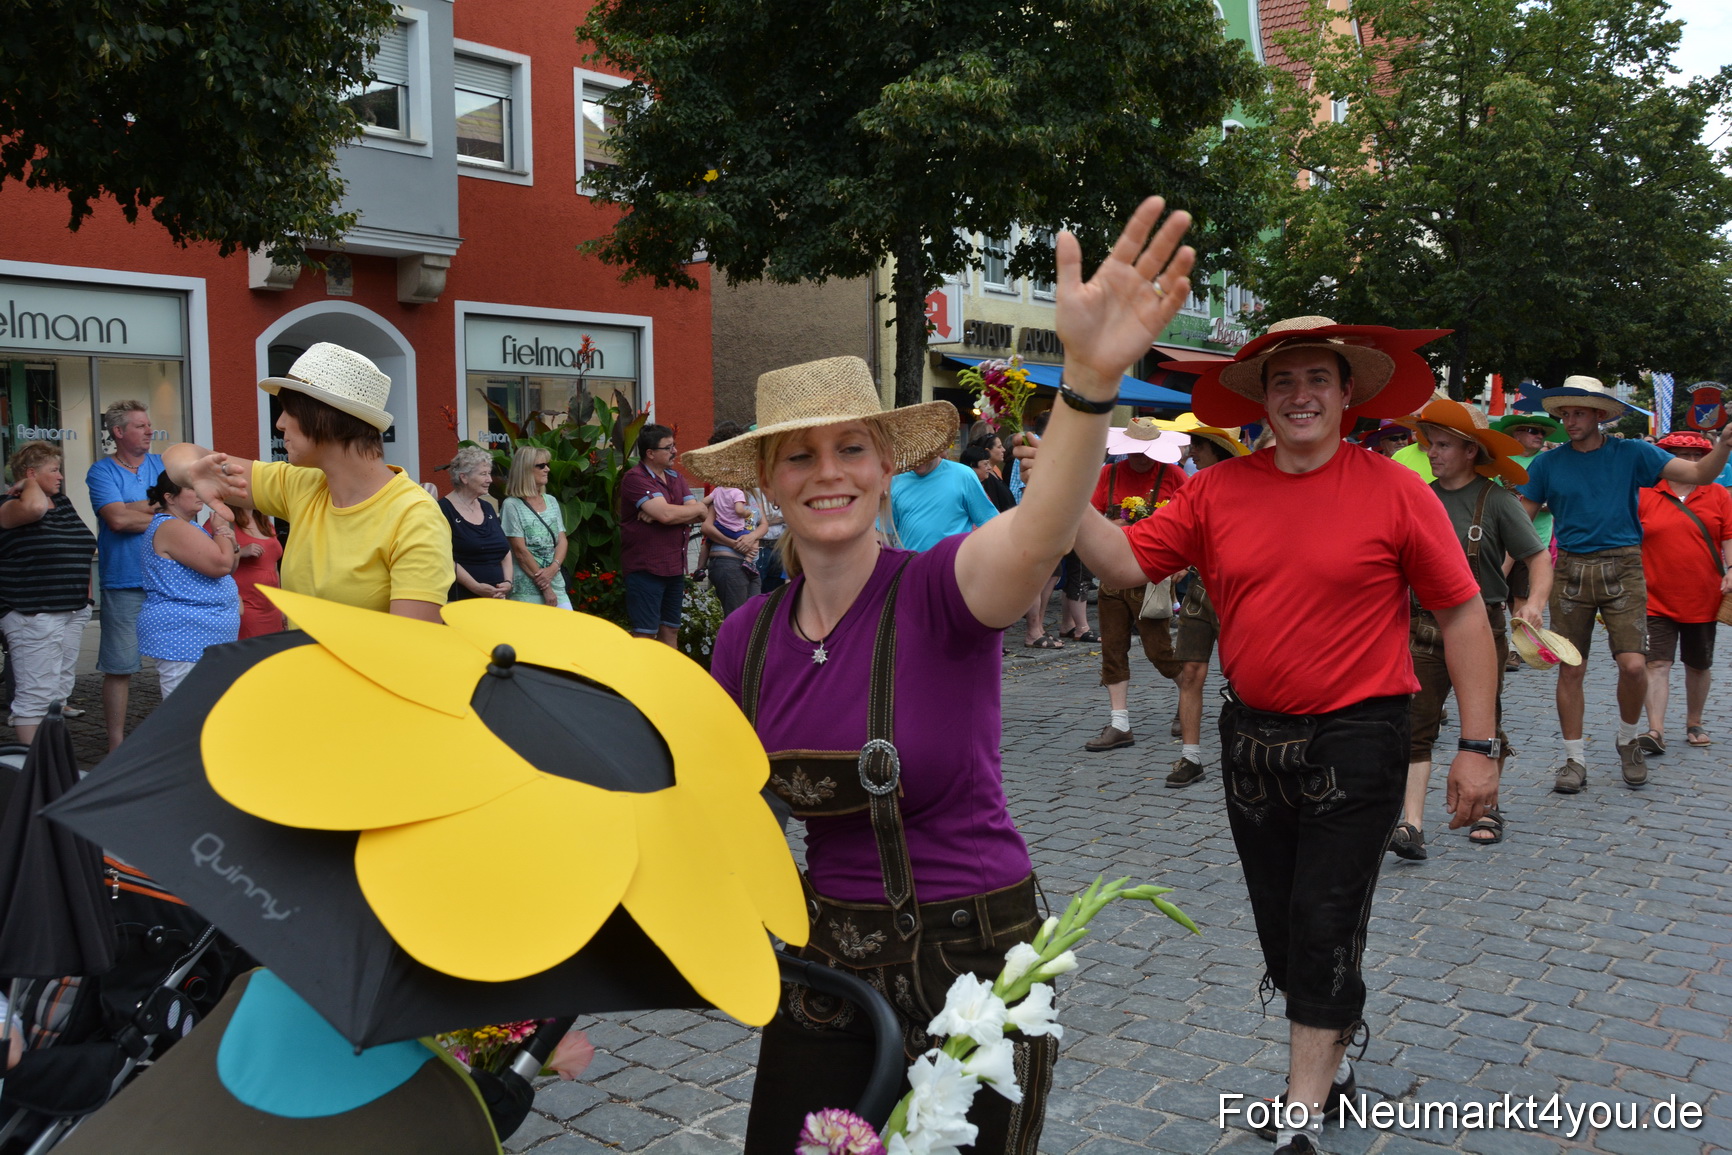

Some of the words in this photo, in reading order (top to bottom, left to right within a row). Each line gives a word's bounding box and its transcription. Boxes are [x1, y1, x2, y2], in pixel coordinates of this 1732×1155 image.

[502, 334, 604, 370] fielmann
[966, 319, 1014, 349] STADT
[190, 832, 291, 920] Quinny
